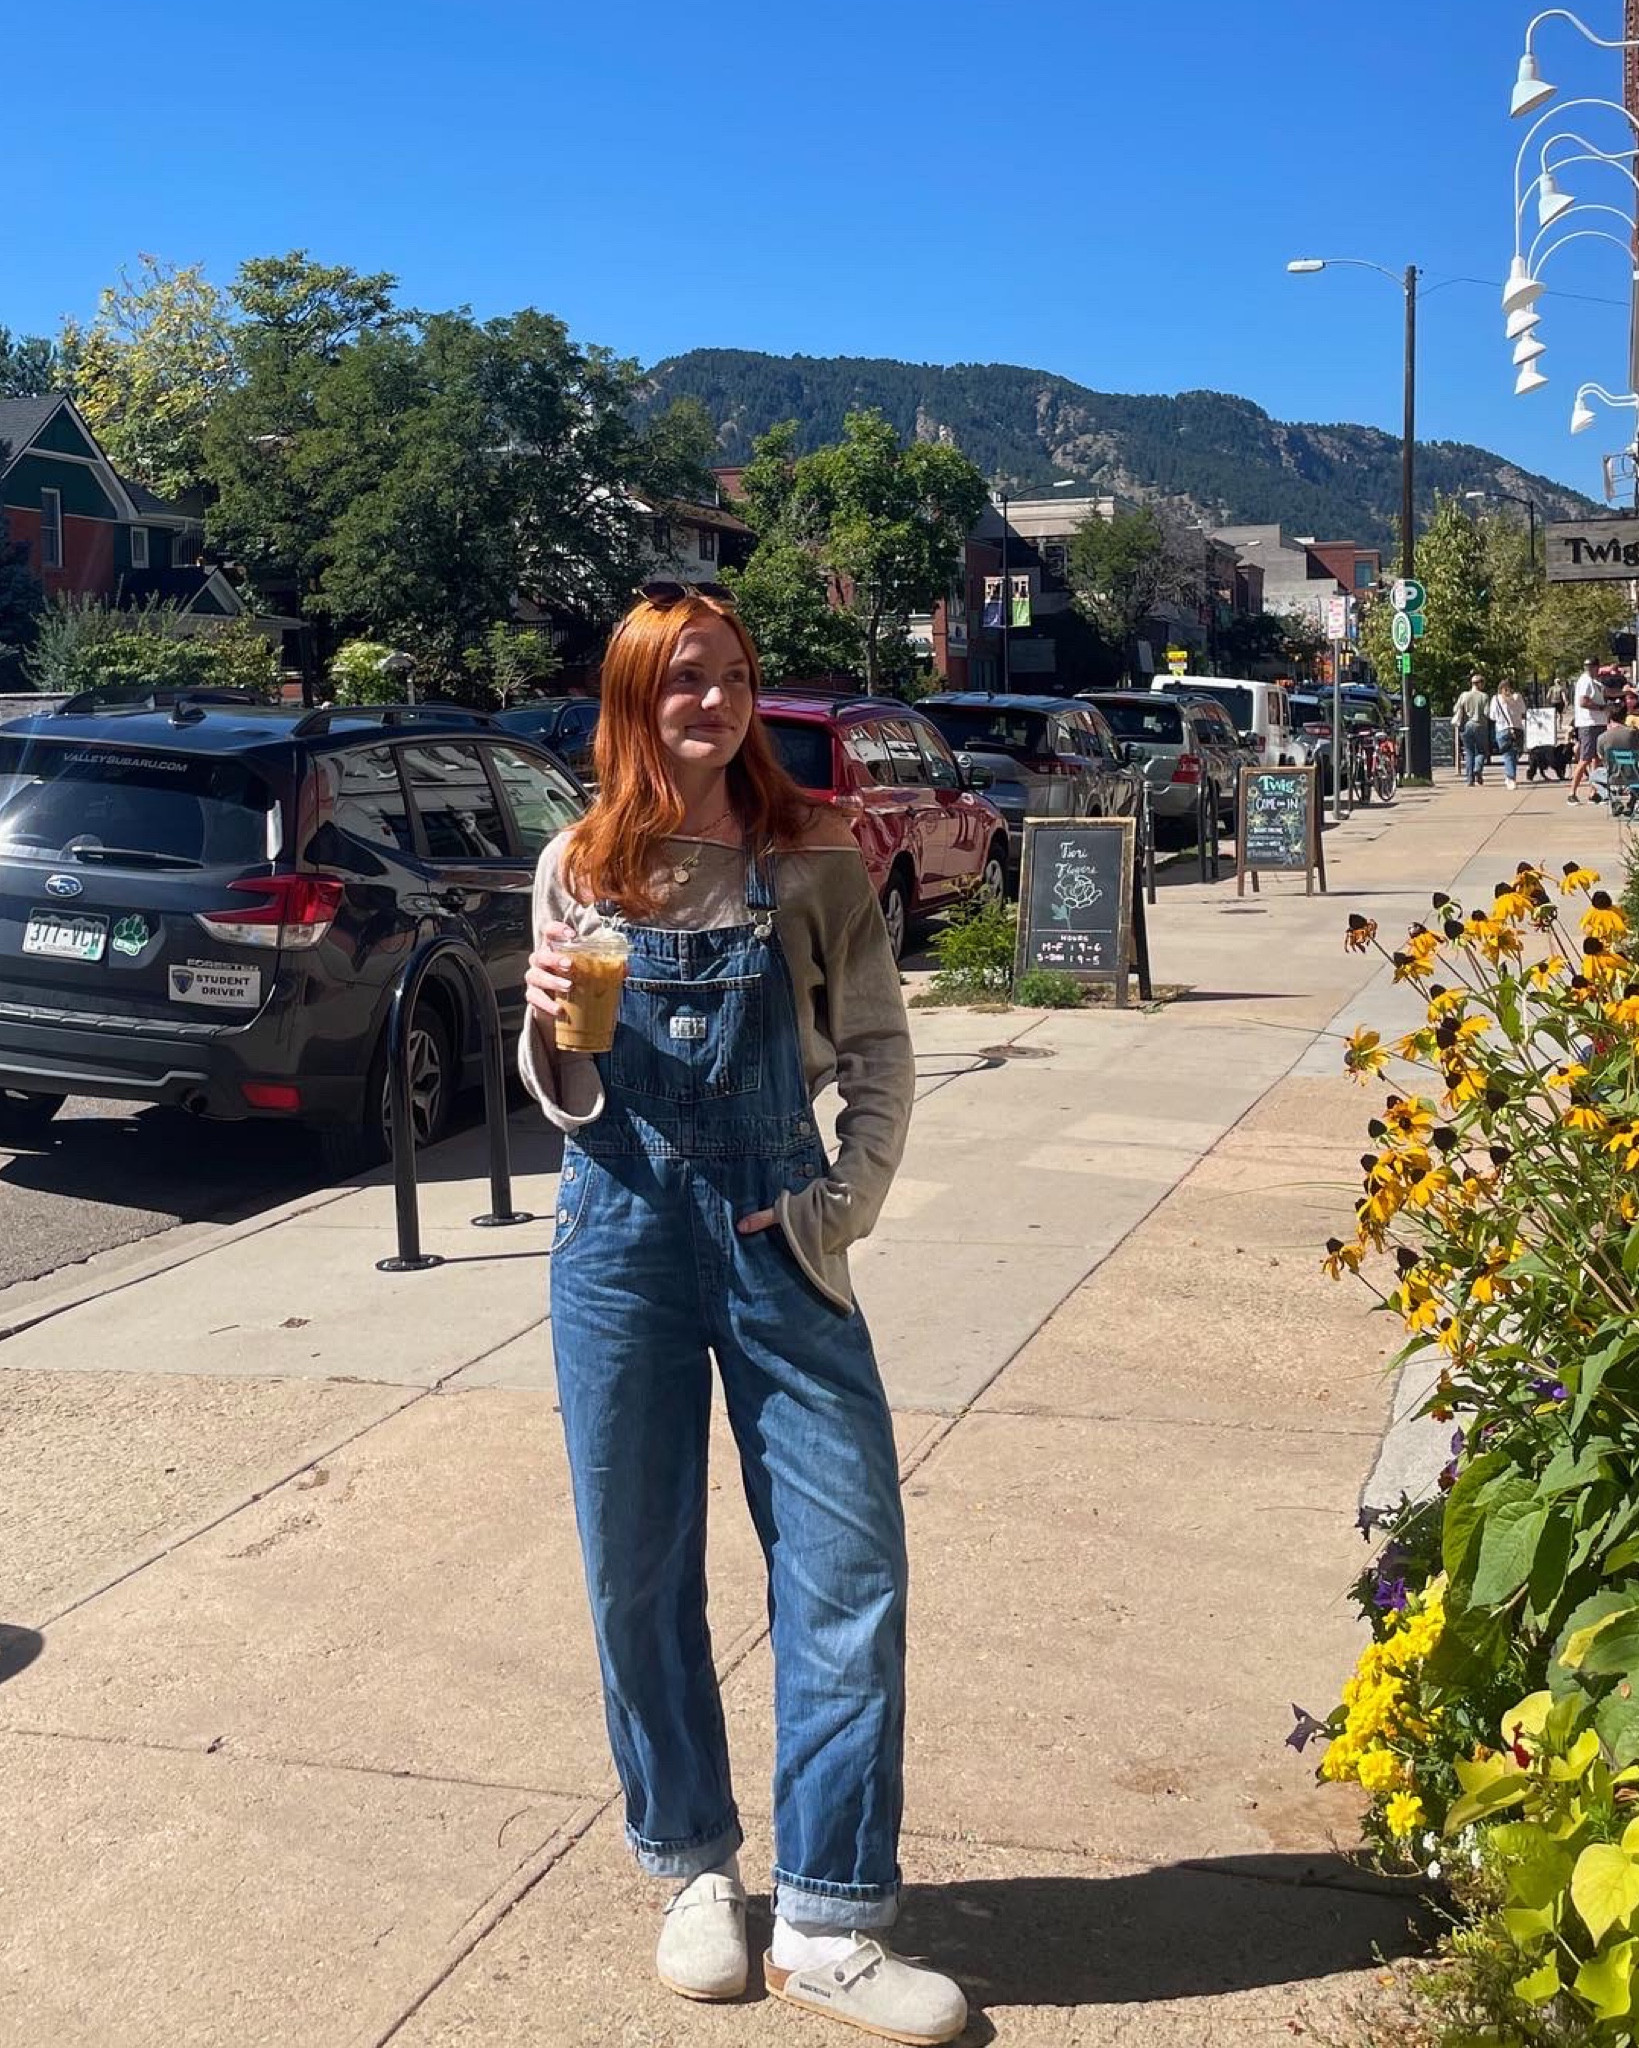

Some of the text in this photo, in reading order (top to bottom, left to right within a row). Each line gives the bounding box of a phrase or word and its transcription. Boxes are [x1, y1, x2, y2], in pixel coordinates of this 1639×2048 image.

[1564, 536, 1639, 567] Twig
[64, 752, 188, 773] VALLEYSUBARU.COM
[1257, 775, 1296, 794] Twig
[196, 974, 250, 986] STUDENT
[202, 986, 244, 998] DRIVER
